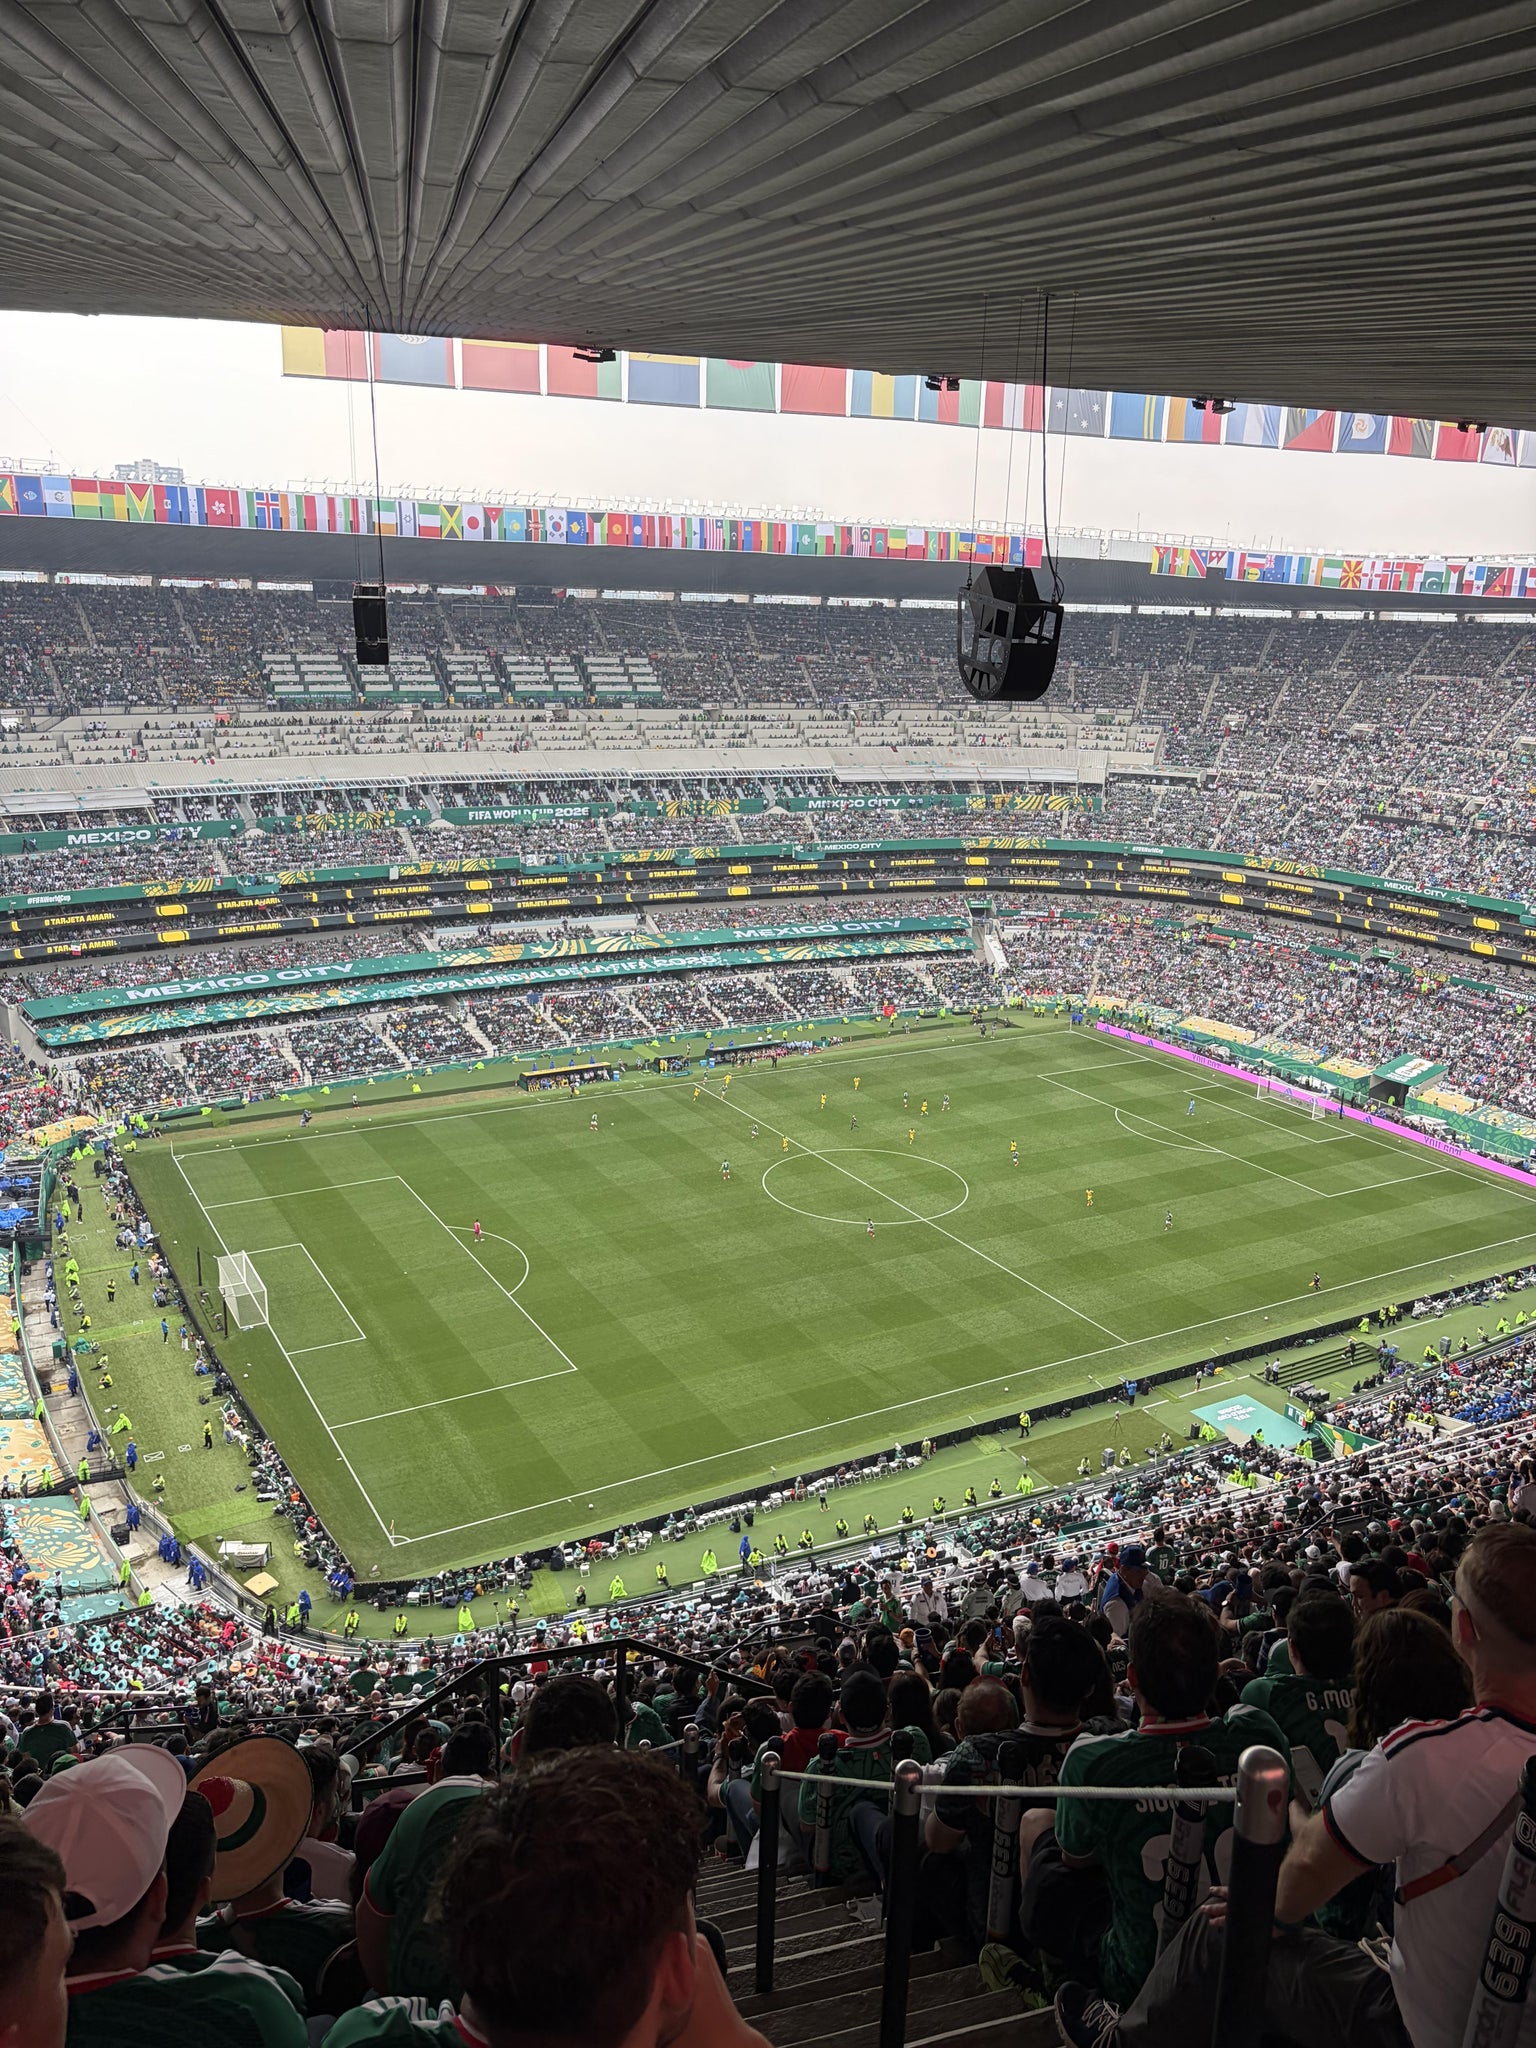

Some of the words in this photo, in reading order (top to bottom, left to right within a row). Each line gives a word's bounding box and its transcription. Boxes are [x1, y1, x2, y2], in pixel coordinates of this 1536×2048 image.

[468, 810, 491, 821] FIFA
[67, 829, 151, 845] MEXICO
[824, 843, 860, 851] MEXICO
[861, 842, 882, 850] CITY
[1384, 881, 1423, 893] MEXICO
[1424, 888, 1448, 898] CITY
[223, 900, 253, 909] TARJETA
[49, 915, 85, 926] TARJETA
[224, 925, 254, 935] TARJETA
[733, 924, 839, 939] MEXICO
[126, 973, 270, 1000] MEXICO
[276, 963, 354, 981] CITY
[408, 980, 463, 993] COPA
[464, 969, 555, 987] MUNDIAL
[1159, 1558, 1169, 1570] 10
[1163, 1857, 1190, 1918] 639
[1506, 1857, 1530, 1913] FILA
[1483, 1912, 1532, 1999] 639
